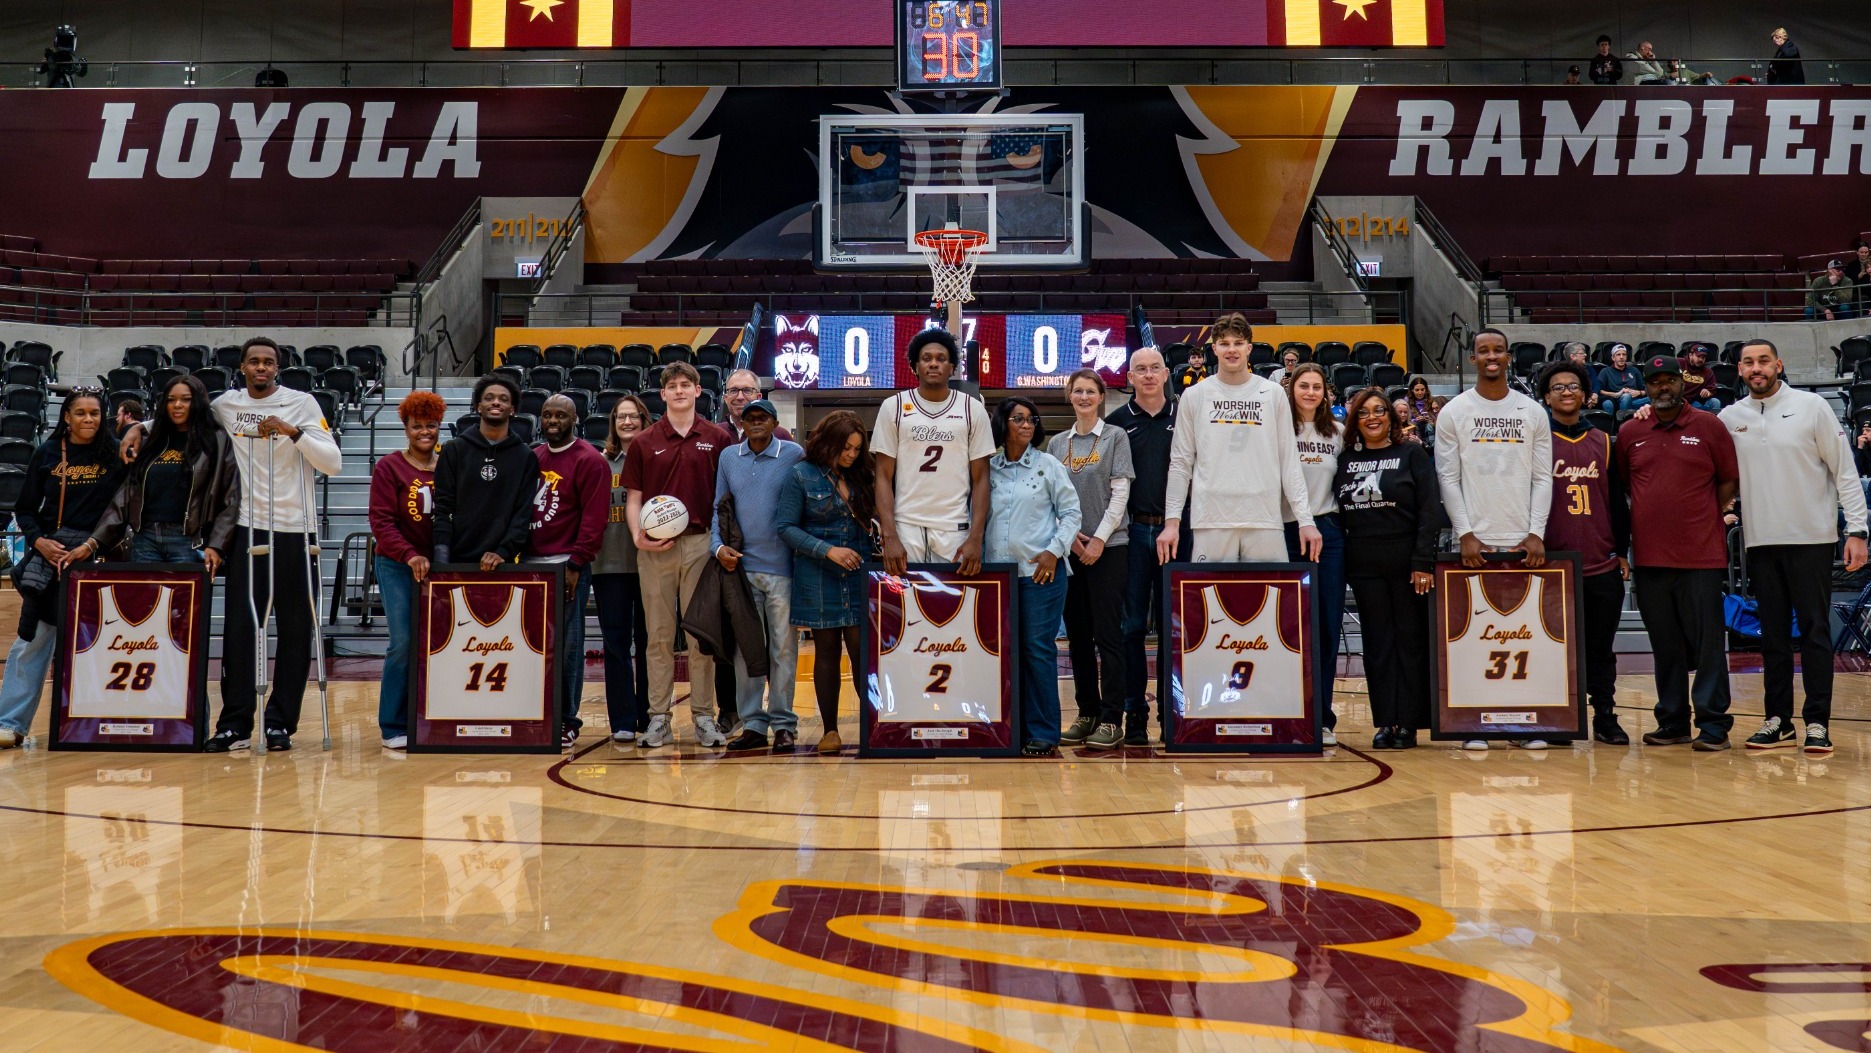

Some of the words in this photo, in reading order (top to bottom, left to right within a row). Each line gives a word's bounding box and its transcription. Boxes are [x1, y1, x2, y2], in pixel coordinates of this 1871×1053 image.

[928, 2, 988, 29] 6:47
[922, 32, 979, 80] 30
[88, 101, 482, 180] LOYOLA
[521, 264, 541, 276] EXIT
[845, 327, 869, 375] 0
[982, 348, 990, 360] 4
[1034, 326, 1058, 374] 0
[982, 361, 990, 373] 0
[1653, 358, 1663, 367] C
[844, 376, 871, 387] LOYOLA
[1017, 375, 1070, 386] G.WASHINGTO
[1213, 400, 1262, 411] WORSHIP.
[1239, 410, 1263, 421] WIN.
[1473, 417, 1524, 429] WORSHIP.
[1500, 428, 1525, 438] WIN.
[919, 445, 944, 473] 2
[1346, 460, 1378, 473] SENIOR
[1377, 457, 1401, 470] MOM
[1552, 459, 1599, 482] Loyola
[418, 485, 435, 514] 1
[544, 490, 560, 521] PROUD
[1355, 502, 1371, 510] Final
[1566, 484, 1592, 515] 31
[407, 500, 423, 521] GOD
[107, 635, 159, 655] Loyola
[1215, 633, 1269, 655] Loyola
[1479, 624, 1533, 645] Loyola
[462, 636, 514, 656] Loyola
[913, 636, 967, 657] Loyola
[1484, 650, 1530, 680] 31
[105, 661, 156, 693] 28
[464, 662, 509, 692] 14
[924, 663, 953, 694] 2
